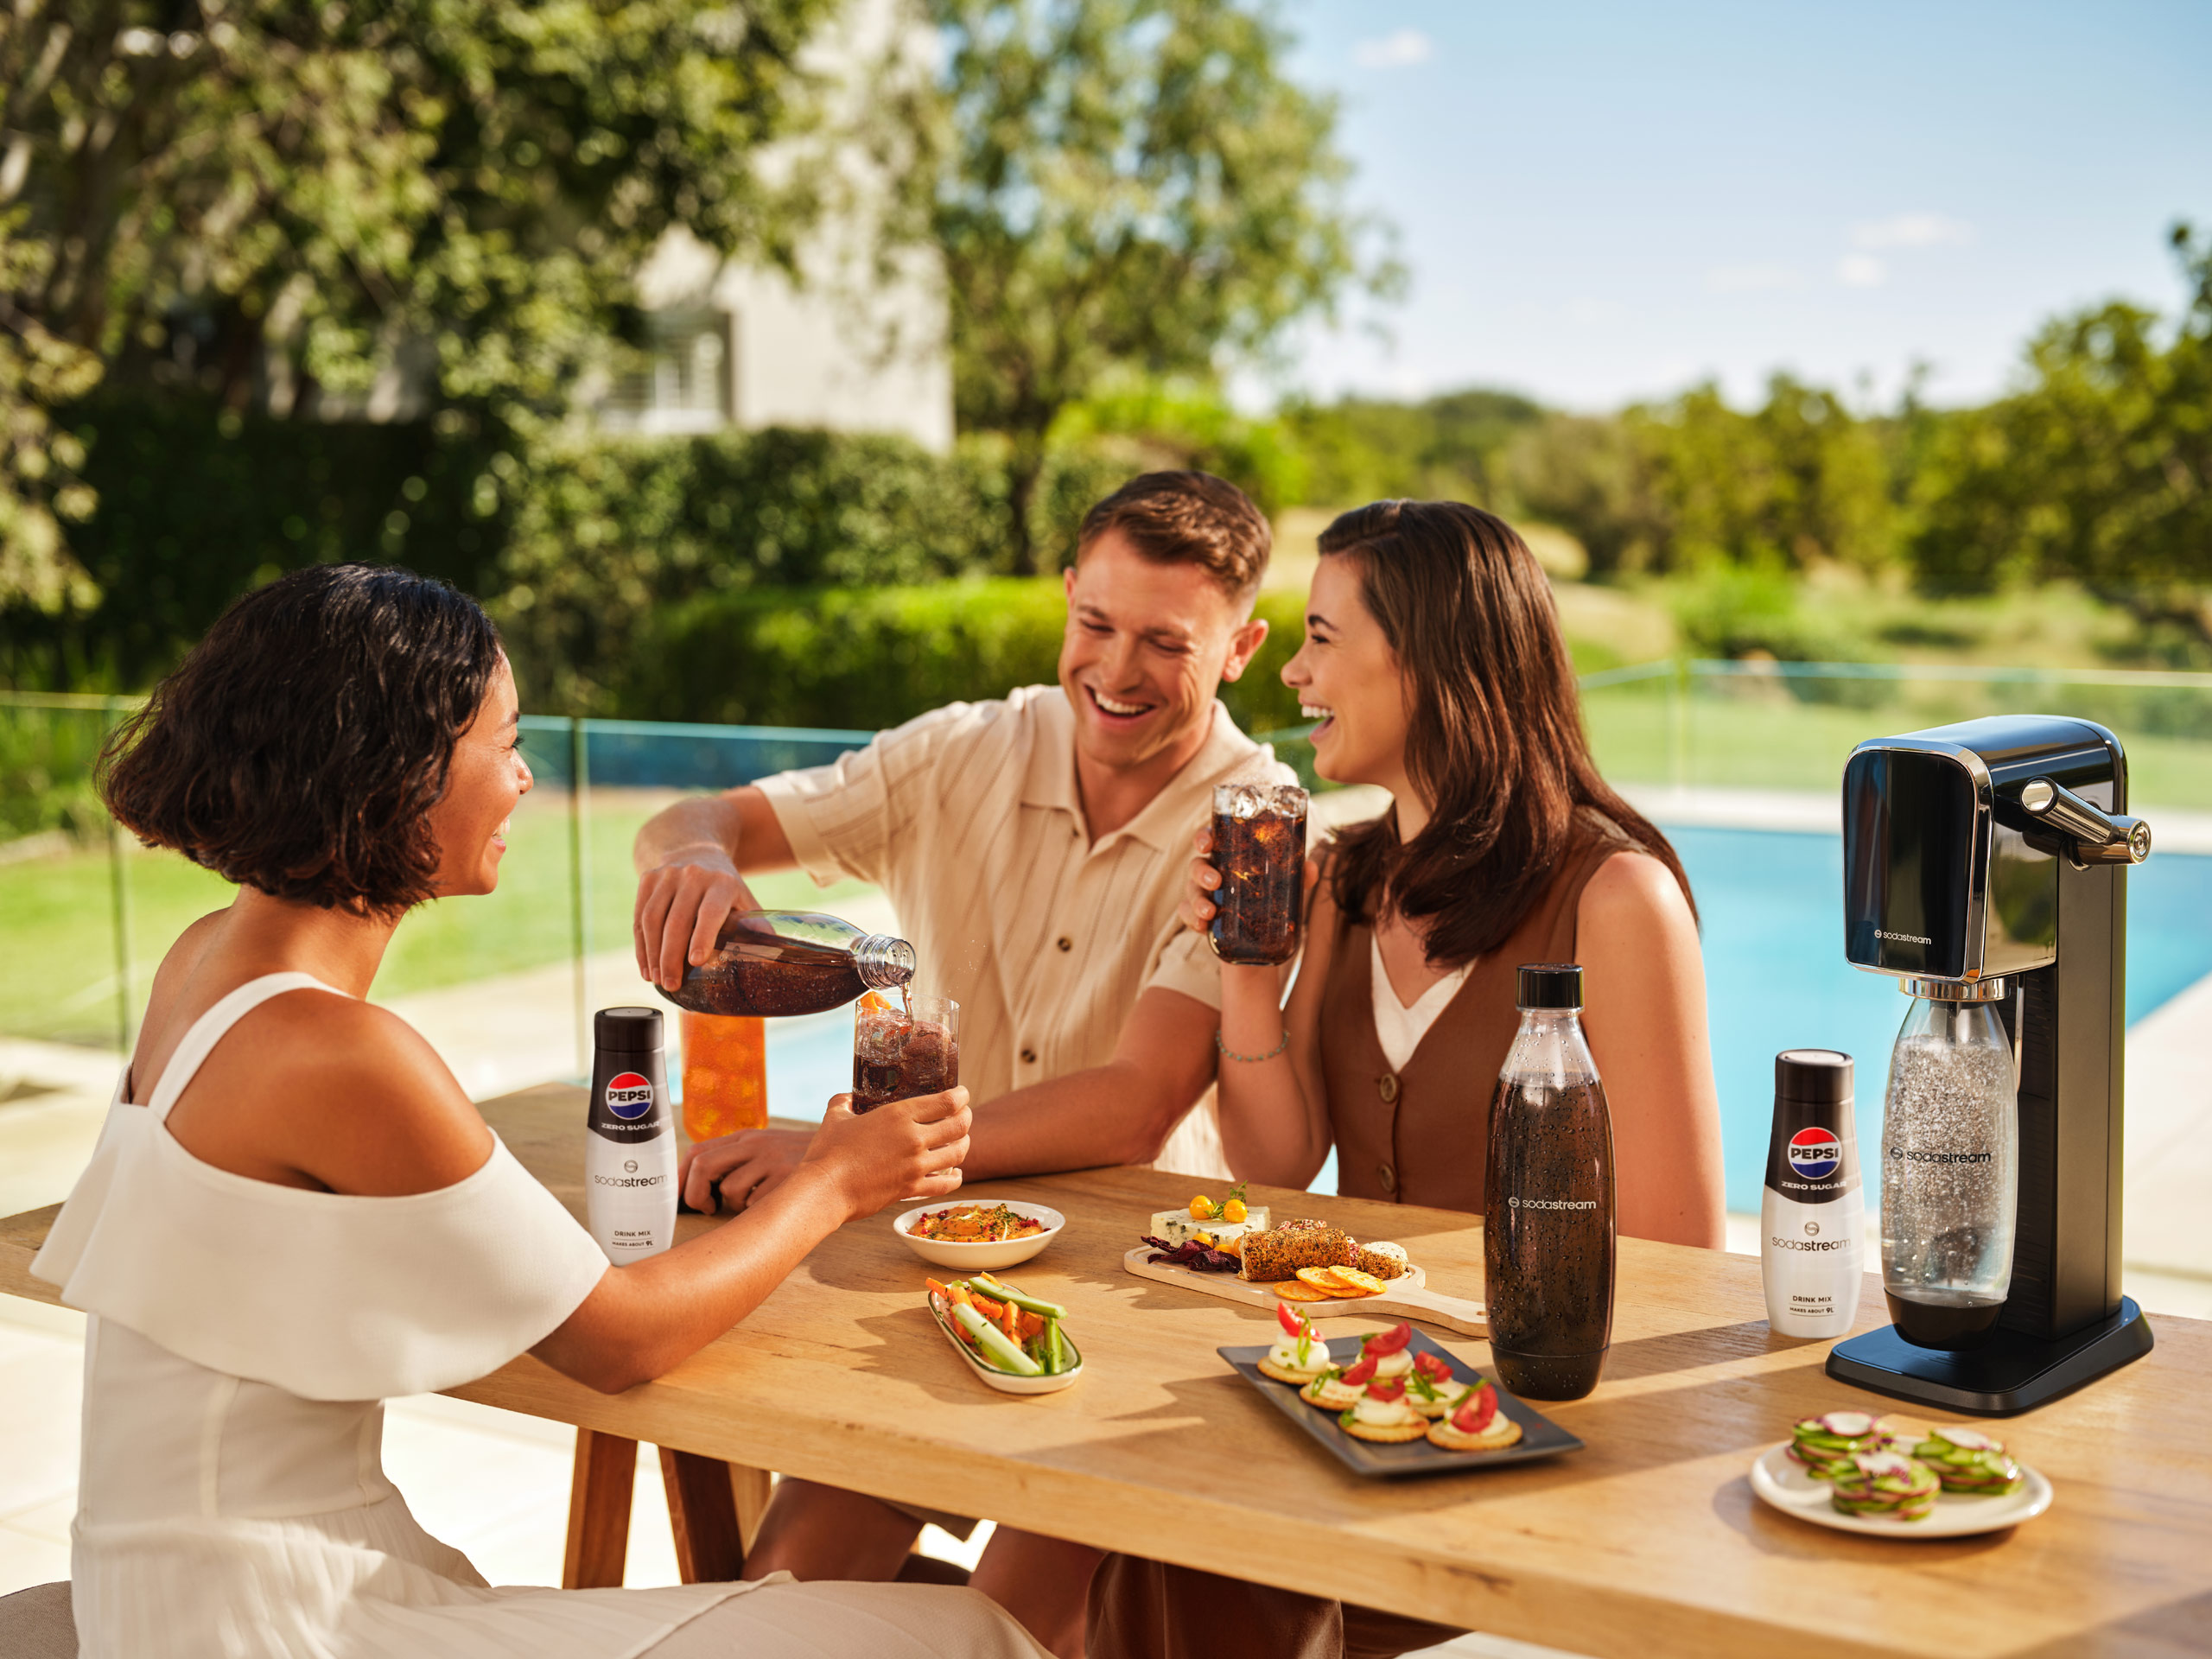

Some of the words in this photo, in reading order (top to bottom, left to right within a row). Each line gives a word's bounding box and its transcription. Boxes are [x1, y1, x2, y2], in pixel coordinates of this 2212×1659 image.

[1883, 931, 1931, 944] sodastream
[608, 1090, 651, 1101] PEPSI
[601, 1122, 626, 1131] ZERO
[626, 1122, 660, 1131] SUGAR
[1790, 1147, 1839, 1160] PEPSI
[1906, 1151, 1992, 1163] sodastream
[594, 1175, 667, 1187] sodastream
[1781, 1180, 1808, 1191] ZERO
[1810, 1180, 1847, 1191] SUGAR
[1522, 1199, 1597, 1210] sodastream
[1771, 1236, 1851, 1251] sodastream
